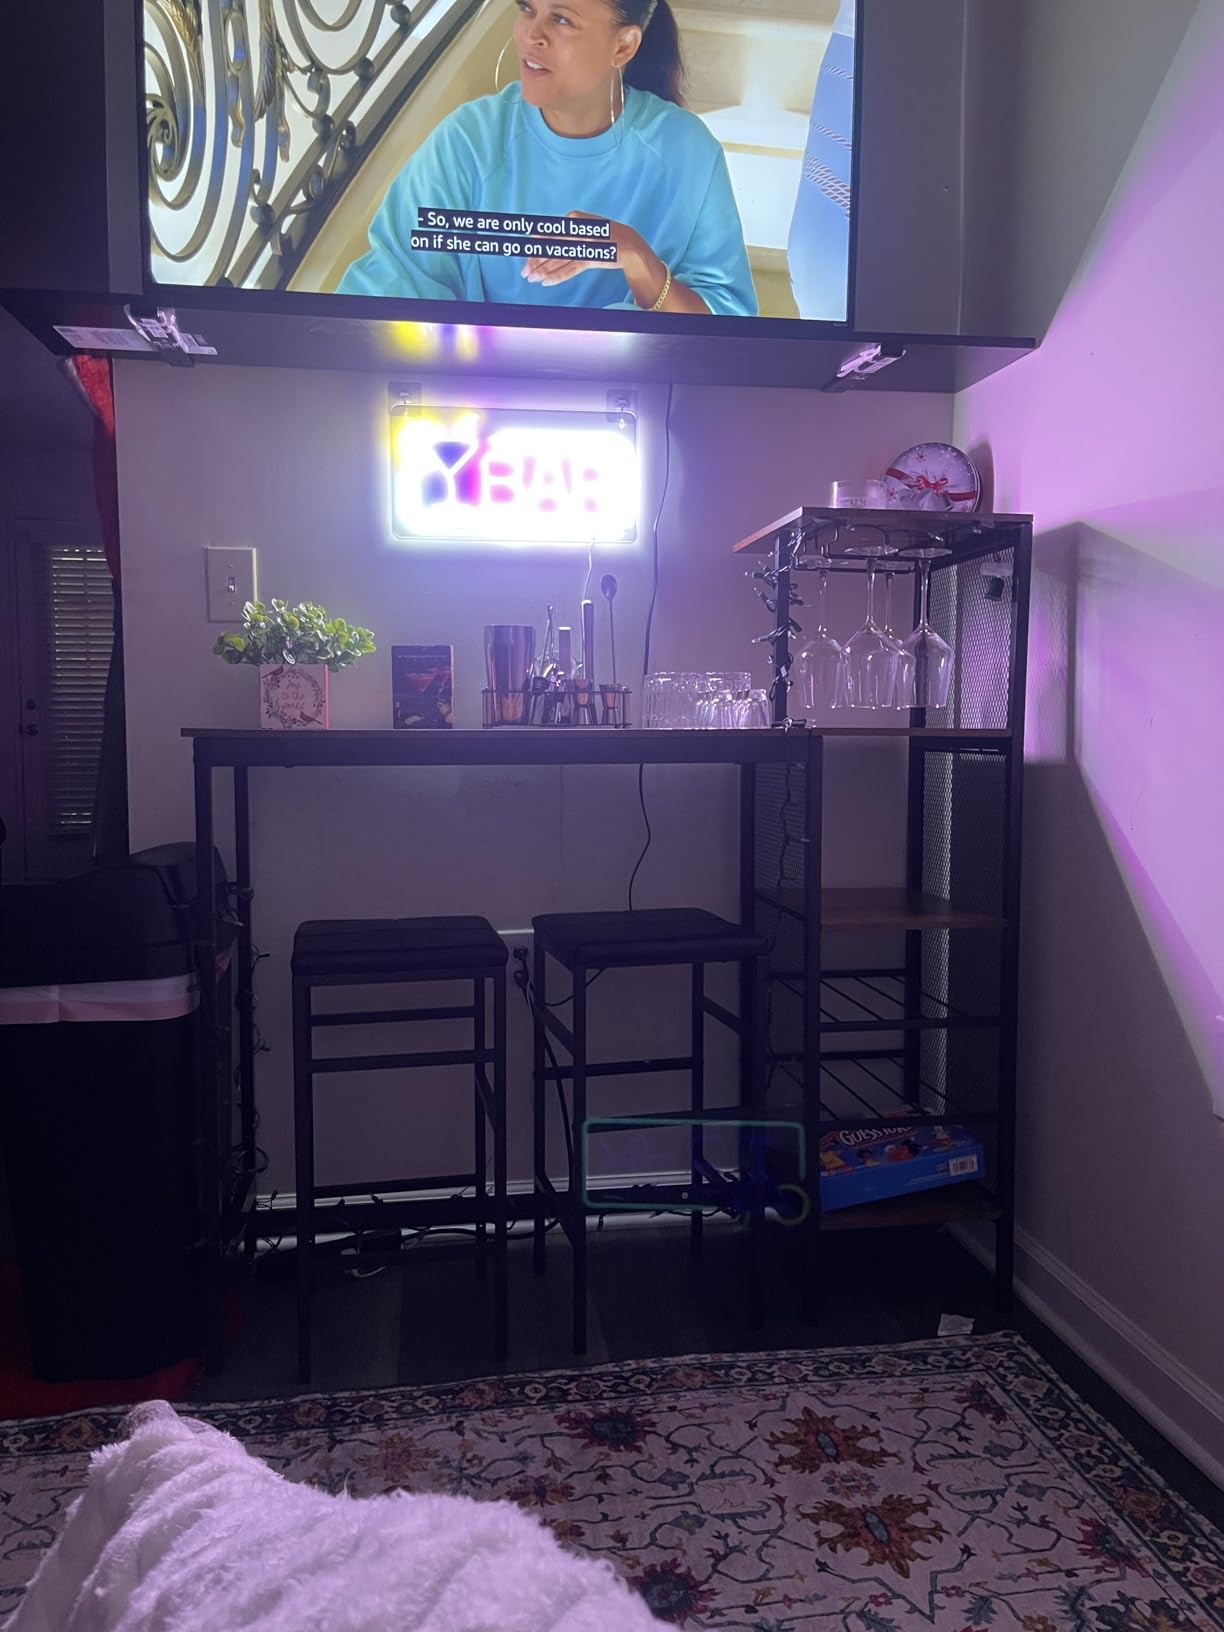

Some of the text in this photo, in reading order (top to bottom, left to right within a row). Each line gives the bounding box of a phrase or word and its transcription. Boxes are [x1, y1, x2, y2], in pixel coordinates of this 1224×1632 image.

[427, 211, 450, 229] So,
[453, 216, 474, 228] we
[477, 217, 499, 230] are
[503, 217, 534, 235] only
[537, 219, 566, 234] cool
[569, 221, 610, 237] based
[410, 235, 617, 260] on if she can go on vacations?
